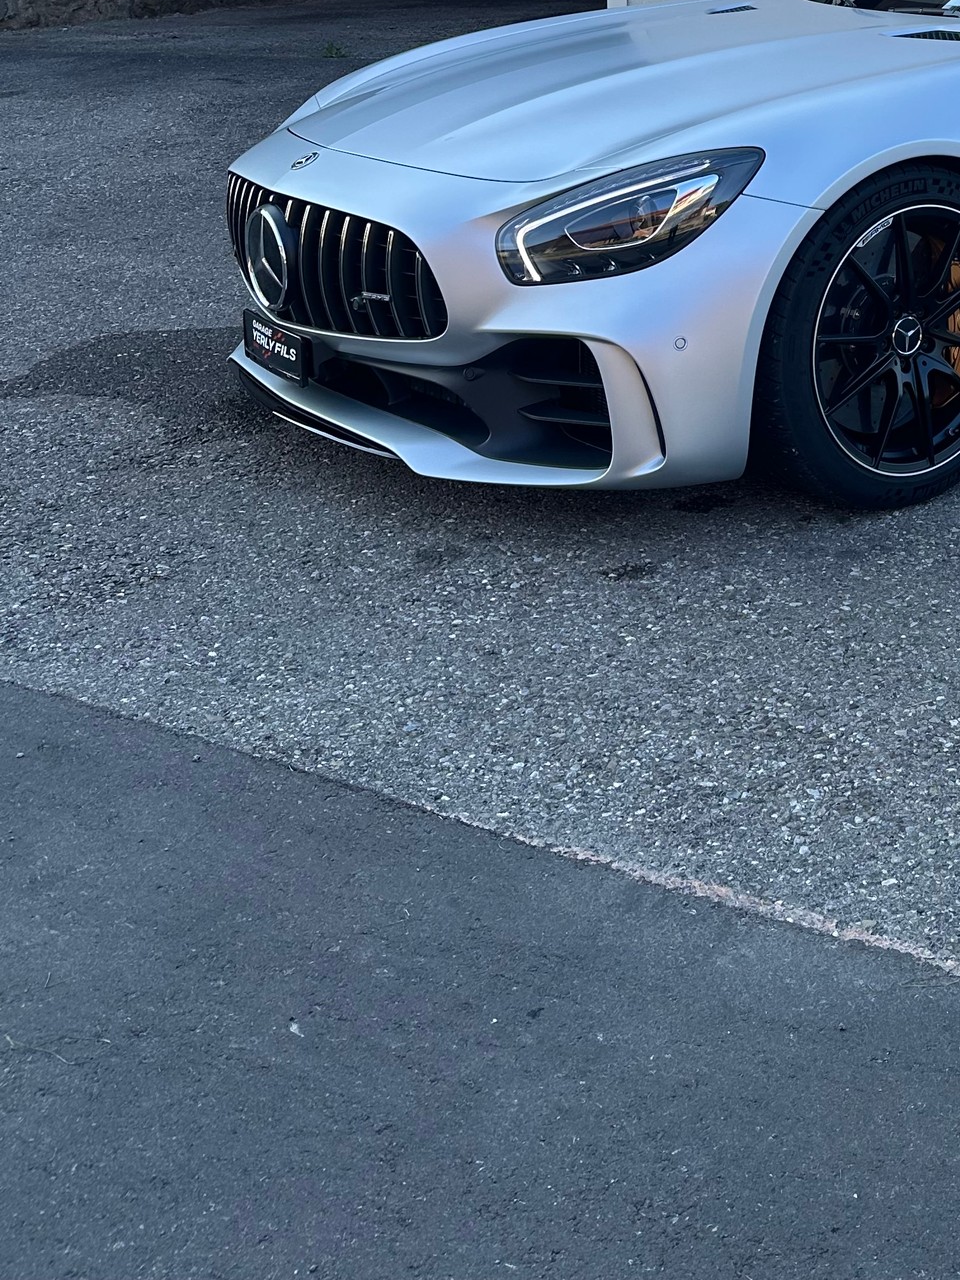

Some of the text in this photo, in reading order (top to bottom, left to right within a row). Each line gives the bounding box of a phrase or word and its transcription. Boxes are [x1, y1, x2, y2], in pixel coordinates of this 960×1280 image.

[852, 179, 926, 221] MICHELIN
[252, 319, 273, 337] GARAGE
[252, 328, 297, 362] YERLY FILS
